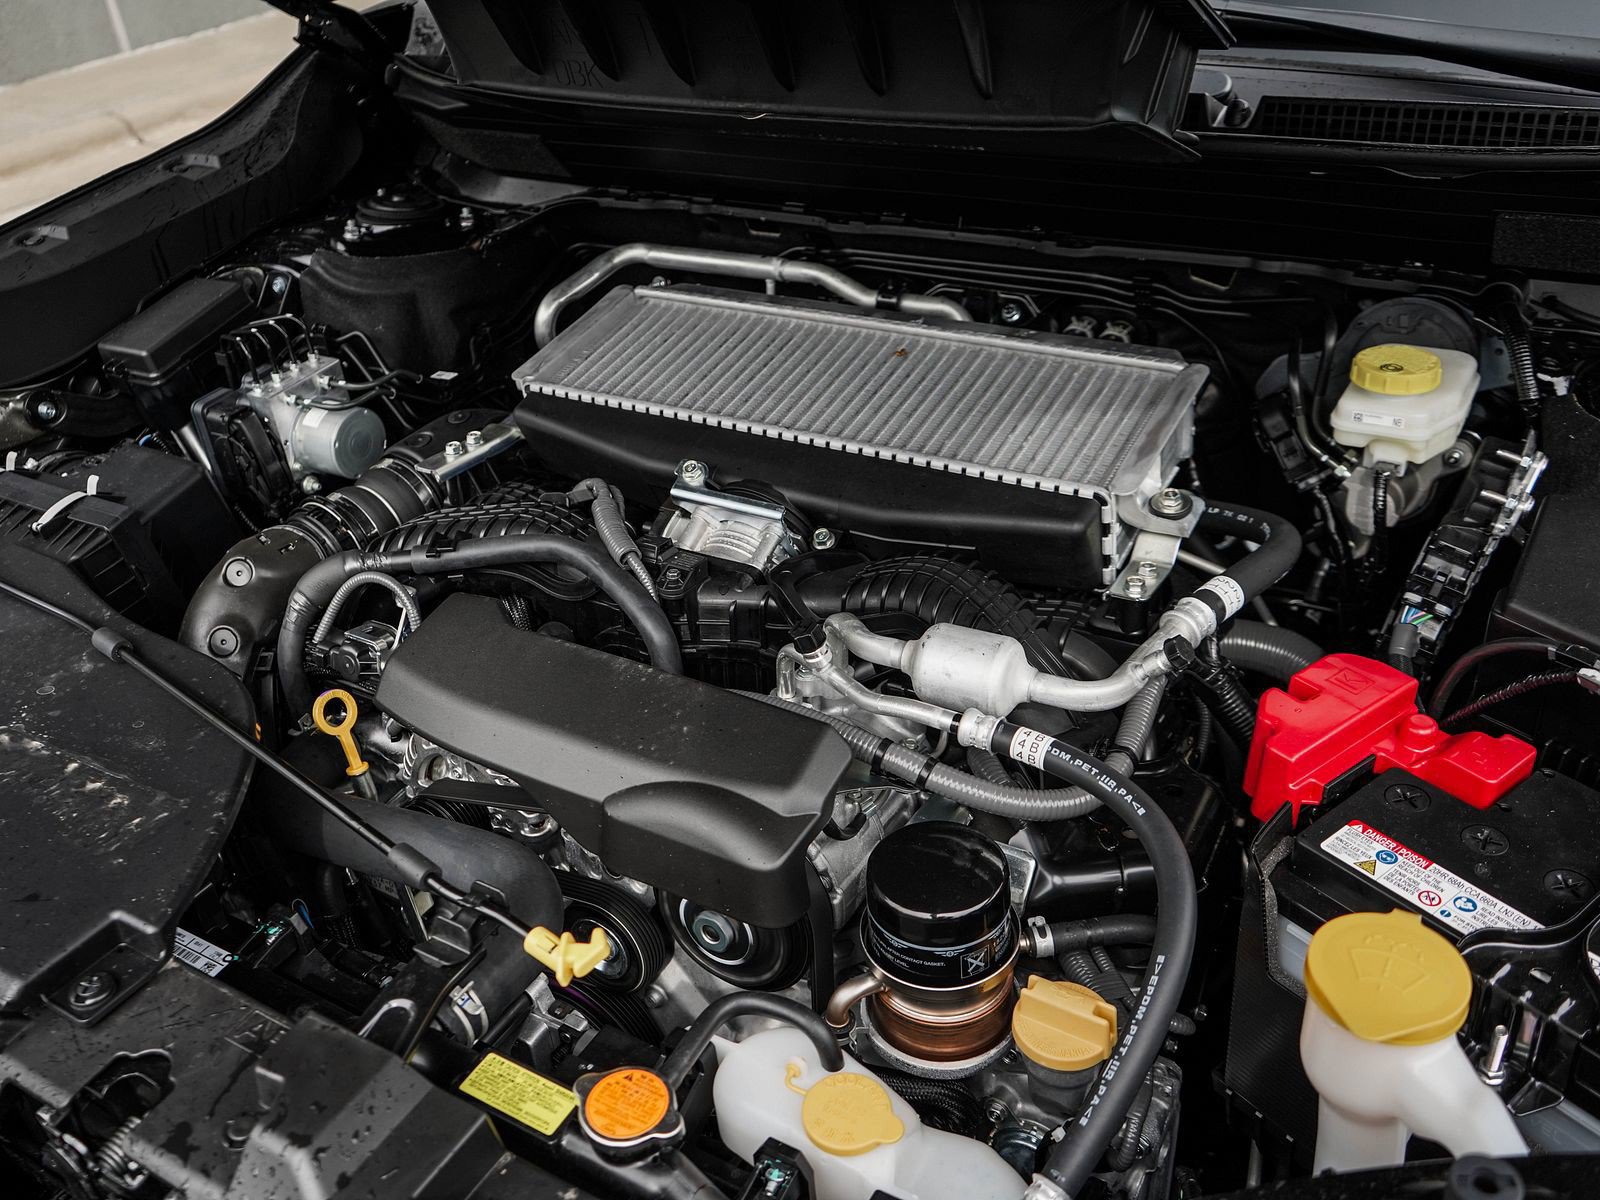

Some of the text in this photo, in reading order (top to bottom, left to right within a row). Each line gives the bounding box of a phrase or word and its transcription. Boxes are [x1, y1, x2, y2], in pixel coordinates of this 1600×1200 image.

[1392, 868, 1407, 878] TENIR
[1401, 860, 1415, 869] KEEP
[1413, 867, 1424, 875] OUT
[1363, 828, 1396, 850] DANGER
[1397, 847, 1428, 868] POISON
[1447, 876, 1465, 889] 68Ah
[1463, 886, 1480, 898] CCA
[1498, 906, 1514, 917] LN3
[1512, 913, 1531, 927] (EN)
[1383, 875, 1415, 895] DES ENFANTS
[1397, 864, 1413, 875] REACH
[1420, 877, 1444, 892] CHILDREN
[1475, 910, 1487, 919] LIRE
[1479, 906, 1495, 917] READ
